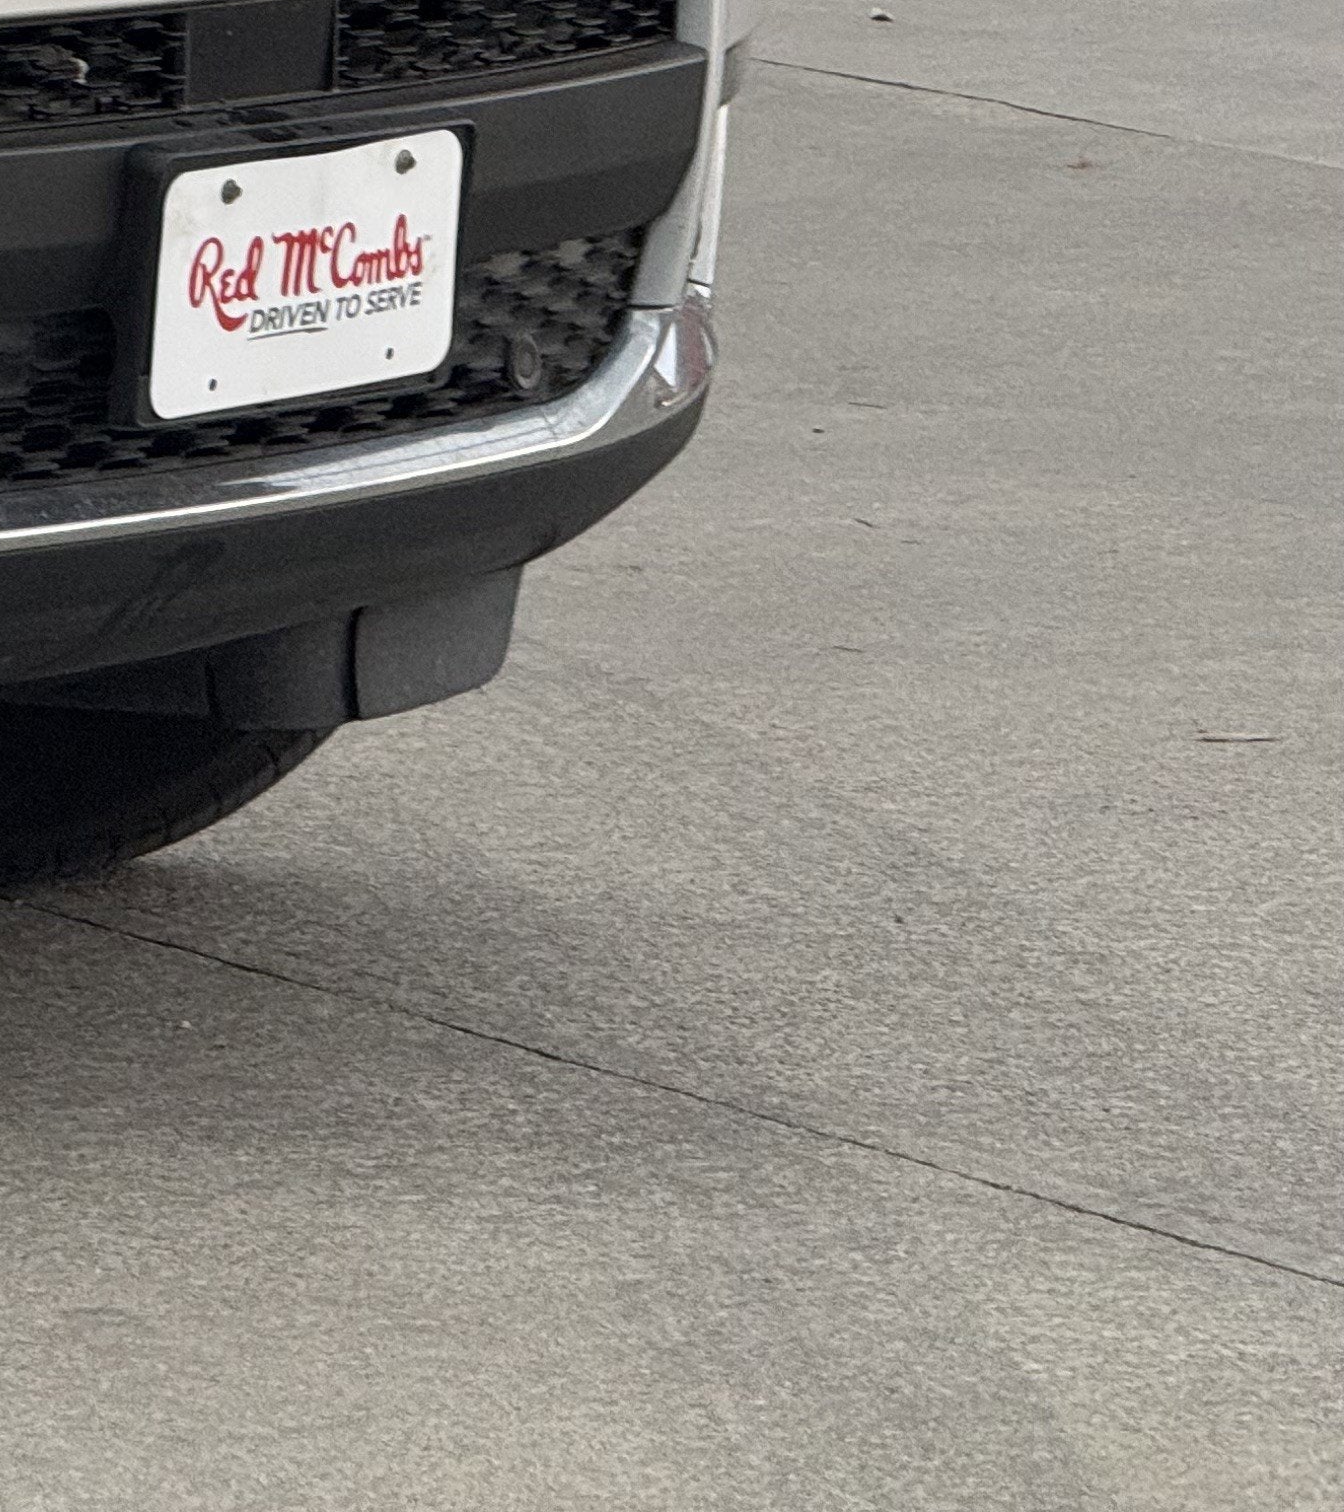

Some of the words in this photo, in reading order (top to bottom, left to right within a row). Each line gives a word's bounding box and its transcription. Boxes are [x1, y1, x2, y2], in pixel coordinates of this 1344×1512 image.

[189, 236, 264, 332] Red
[272, 214, 424, 296] McCombs
[248, 299, 331, 333] DRIVEN
[335, 293, 361, 321] TO
[365, 281, 423, 316] SERVE
